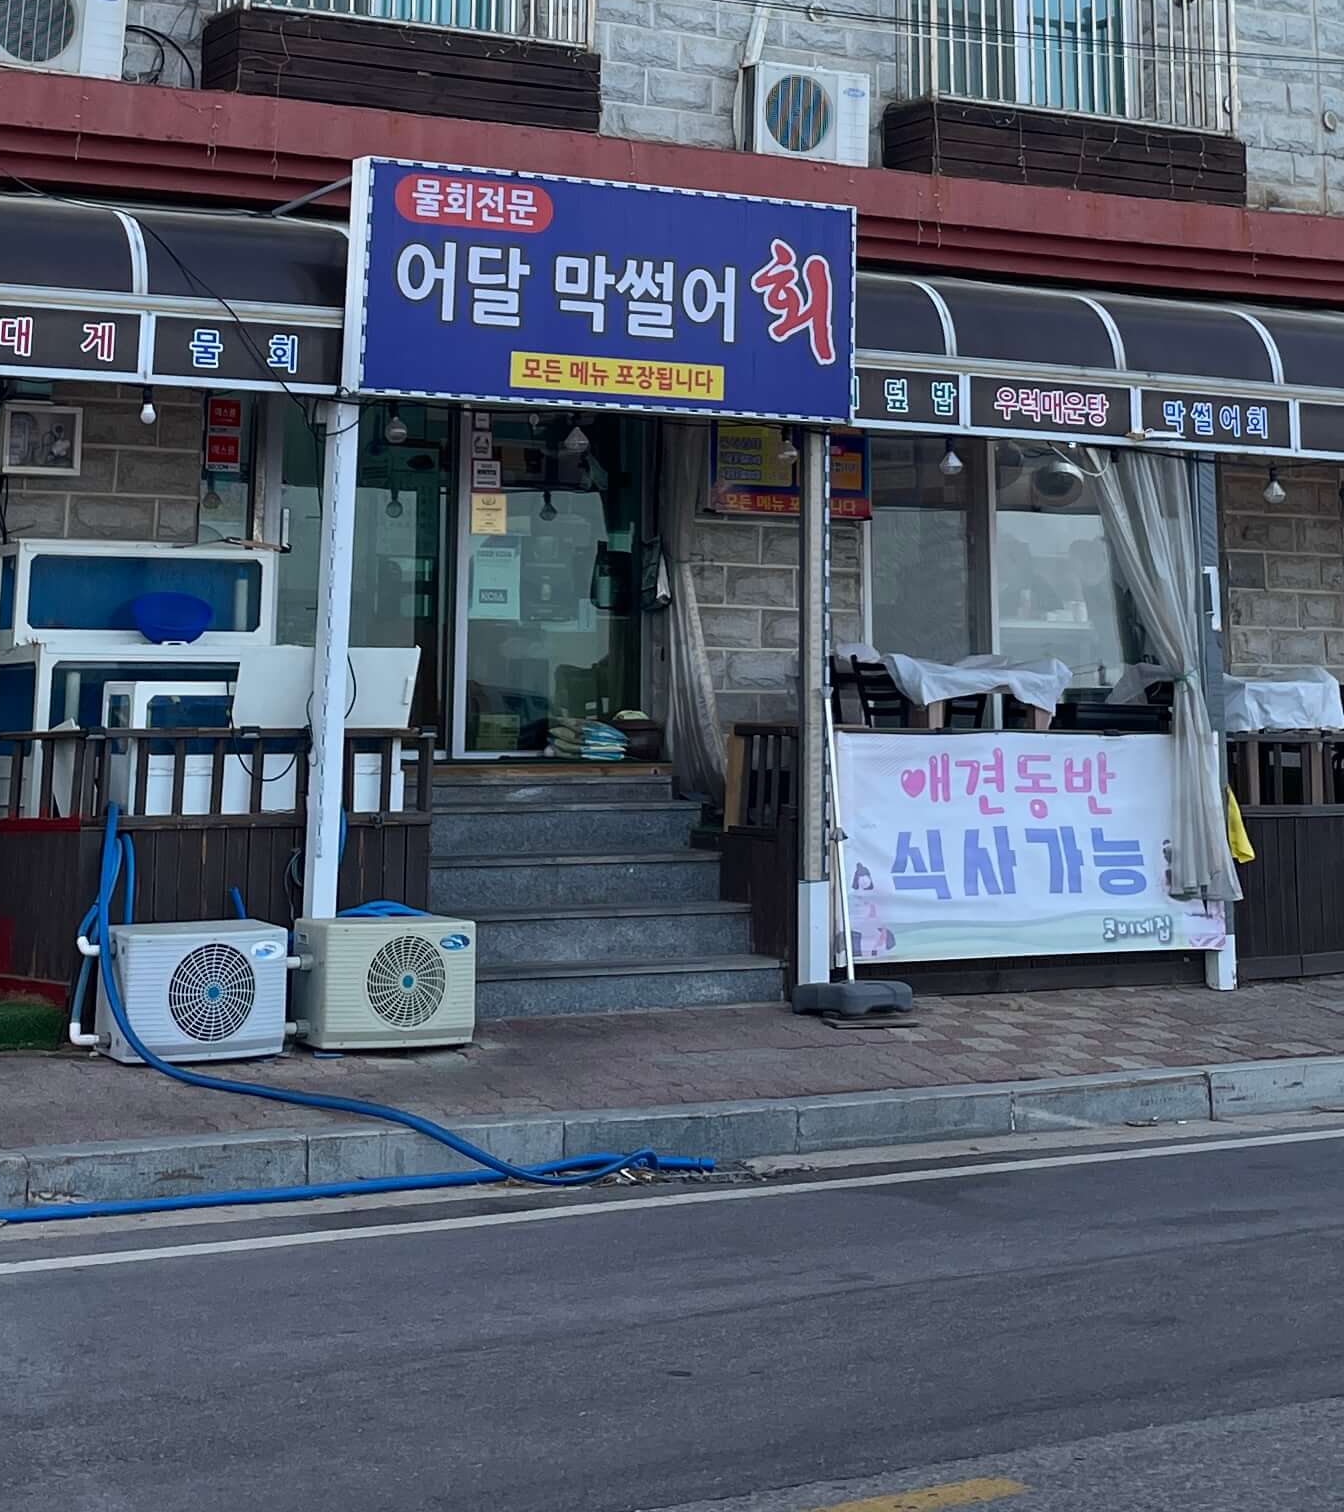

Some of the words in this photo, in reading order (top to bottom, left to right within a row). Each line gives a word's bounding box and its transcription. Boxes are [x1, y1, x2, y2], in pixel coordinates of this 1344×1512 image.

[411, 178, 539, 227] 물회전문
[396, 240, 532, 328] 어달
[553, 255, 737, 344] 막썰어
[188, 327, 299, 374] 물회
[521, 358, 564, 384] 모든
[569, 361, 609, 387] 메뉴
[616, 364, 715, 395] 포장됩니다
[993, 385, 1109, 428] 우럭매운탕
[1162, 399, 1269, 439] 막썰어회
[899, 747, 1117, 819] 애견동반
[890, 825, 1147, 900] 식사가능
